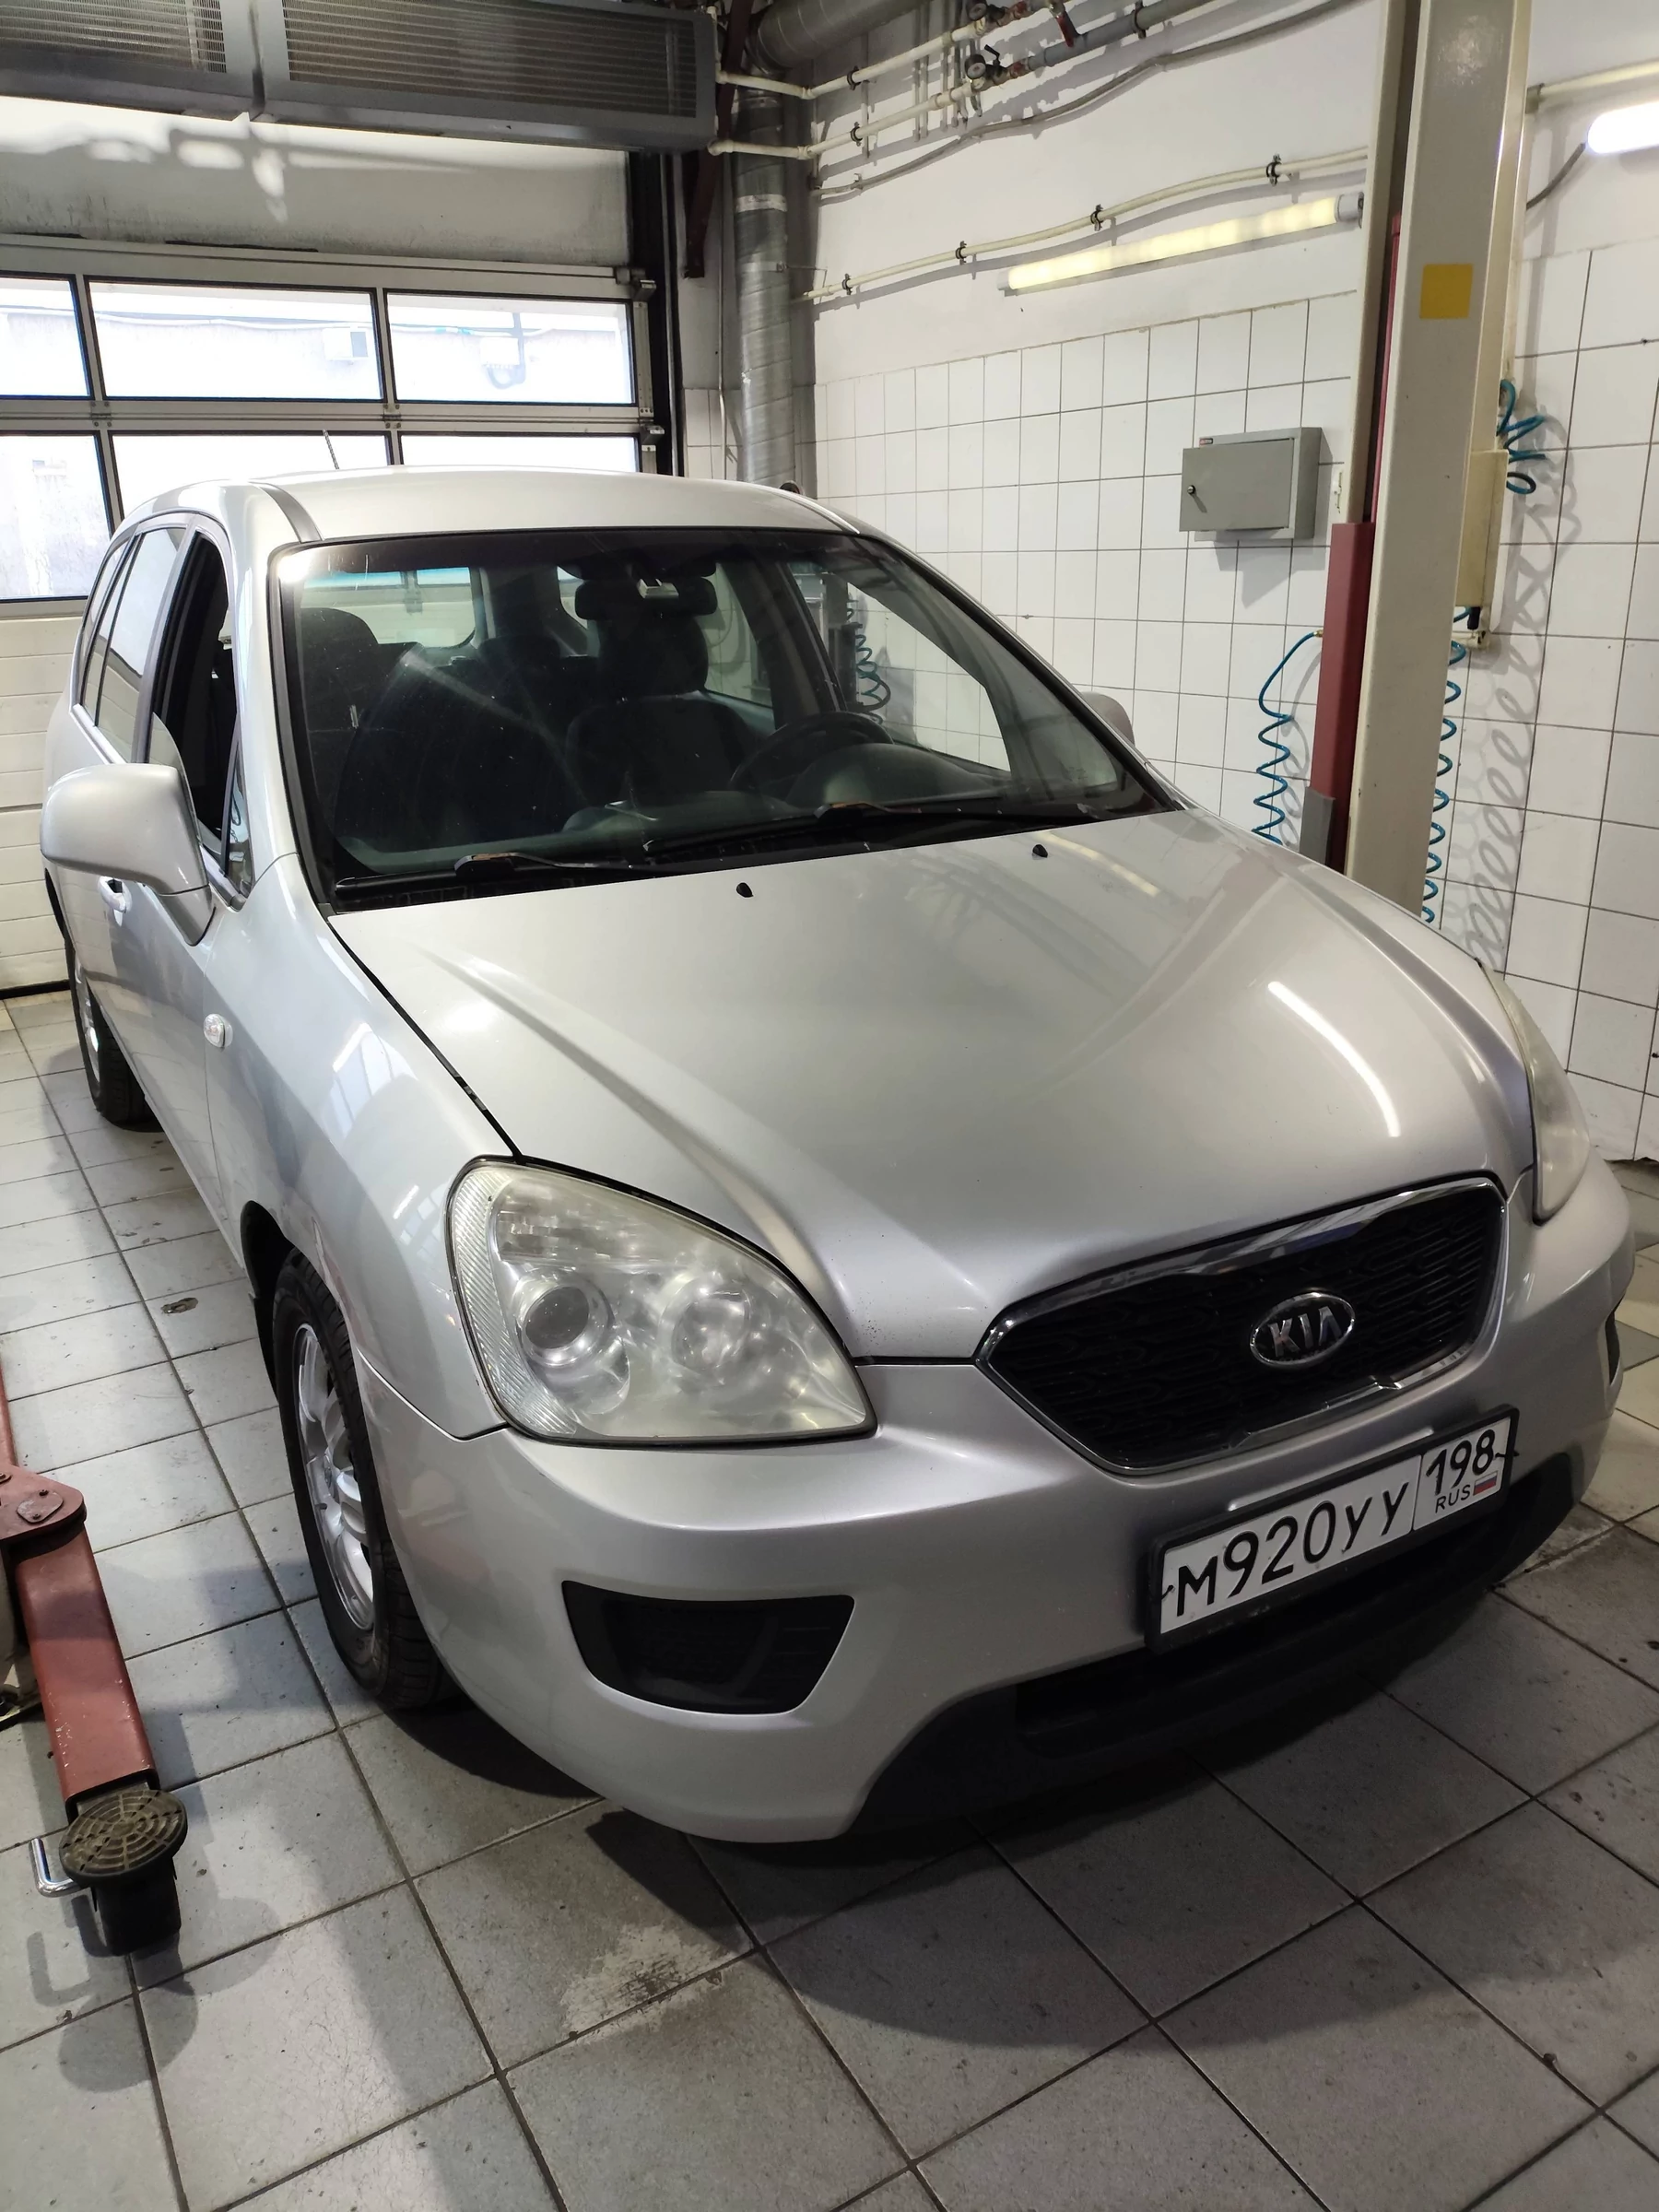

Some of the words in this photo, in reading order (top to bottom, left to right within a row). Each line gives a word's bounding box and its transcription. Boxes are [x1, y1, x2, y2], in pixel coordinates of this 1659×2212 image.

[1268, 1306, 1342, 1358] KIA
[1427, 1430, 1495, 1495] 198
[1436, 1485, 1471, 1513] RUS
